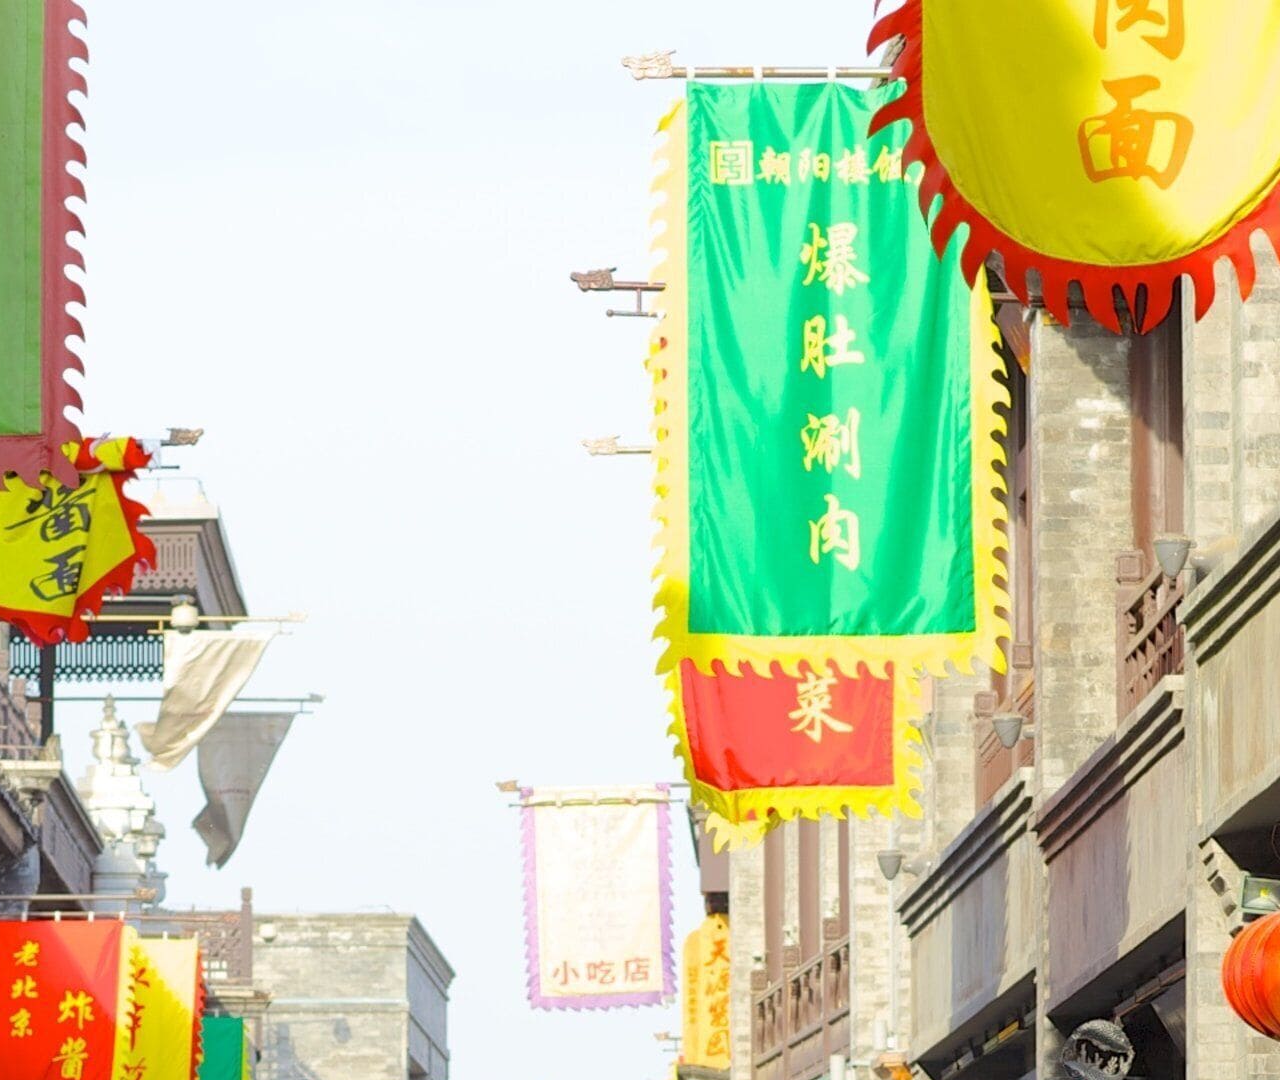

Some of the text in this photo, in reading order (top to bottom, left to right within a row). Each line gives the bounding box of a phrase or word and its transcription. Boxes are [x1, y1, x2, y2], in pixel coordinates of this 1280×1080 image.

[800, 222, 870, 571] 爆肚涮肉
[9, 940, 40, 1038] 老北京
[552, 958, 650, 985] 小吃店
